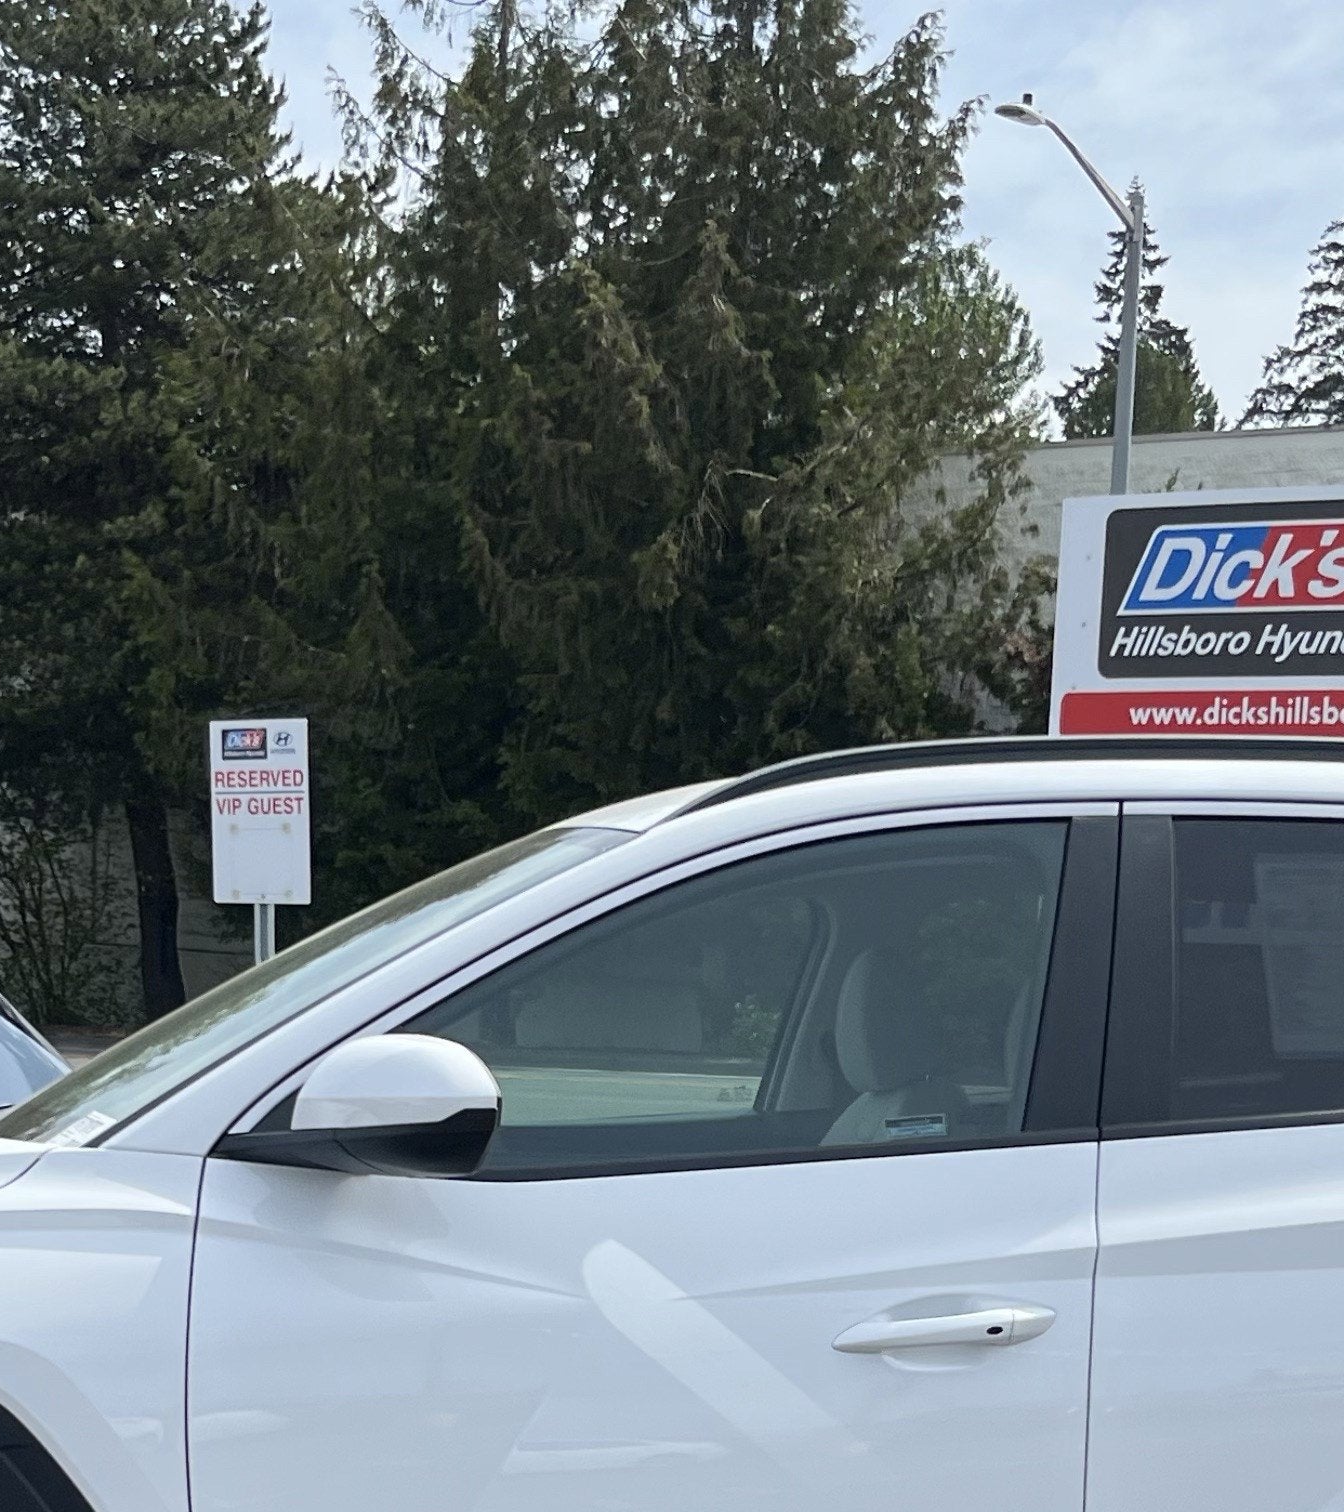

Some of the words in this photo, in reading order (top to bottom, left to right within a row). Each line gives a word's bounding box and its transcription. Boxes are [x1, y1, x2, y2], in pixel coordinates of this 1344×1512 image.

[1109, 625, 1252, 658] Hillsboro
[214, 769, 304, 788] RESERVED
[216, 798, 242, 815] VIP
[247, 797, 304, 815] GUEST
